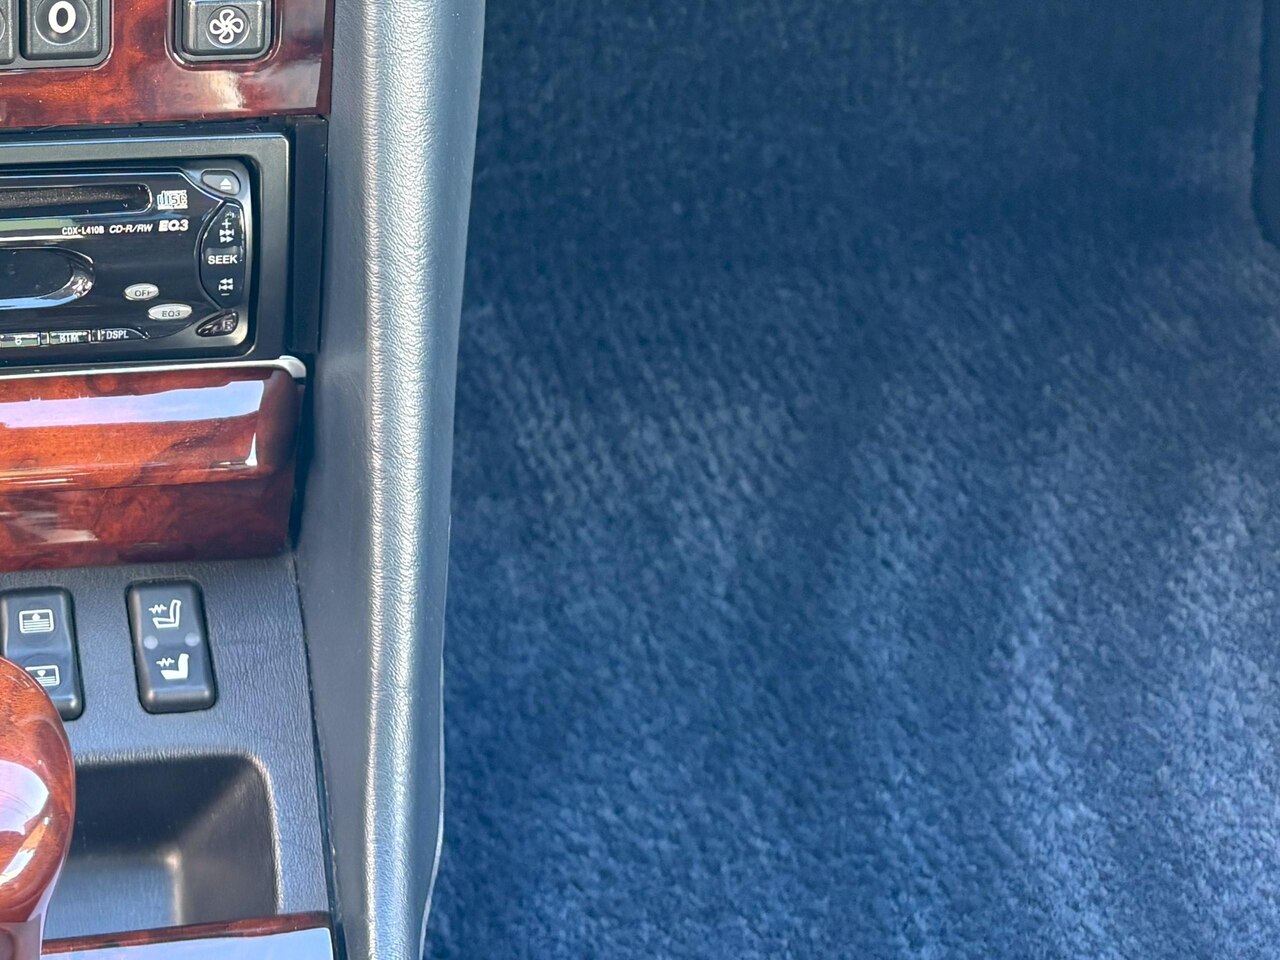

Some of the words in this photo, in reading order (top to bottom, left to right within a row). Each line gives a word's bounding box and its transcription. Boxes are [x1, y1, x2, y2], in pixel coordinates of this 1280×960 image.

[108, 223, 154, 234] CD-R/RW
[158, 219, 189, 232] EQ3
[207, 254, 238, 265] SEEK
[161, 310, 181, 318] EQ3
[106, 330, 129, 340] DSPL
